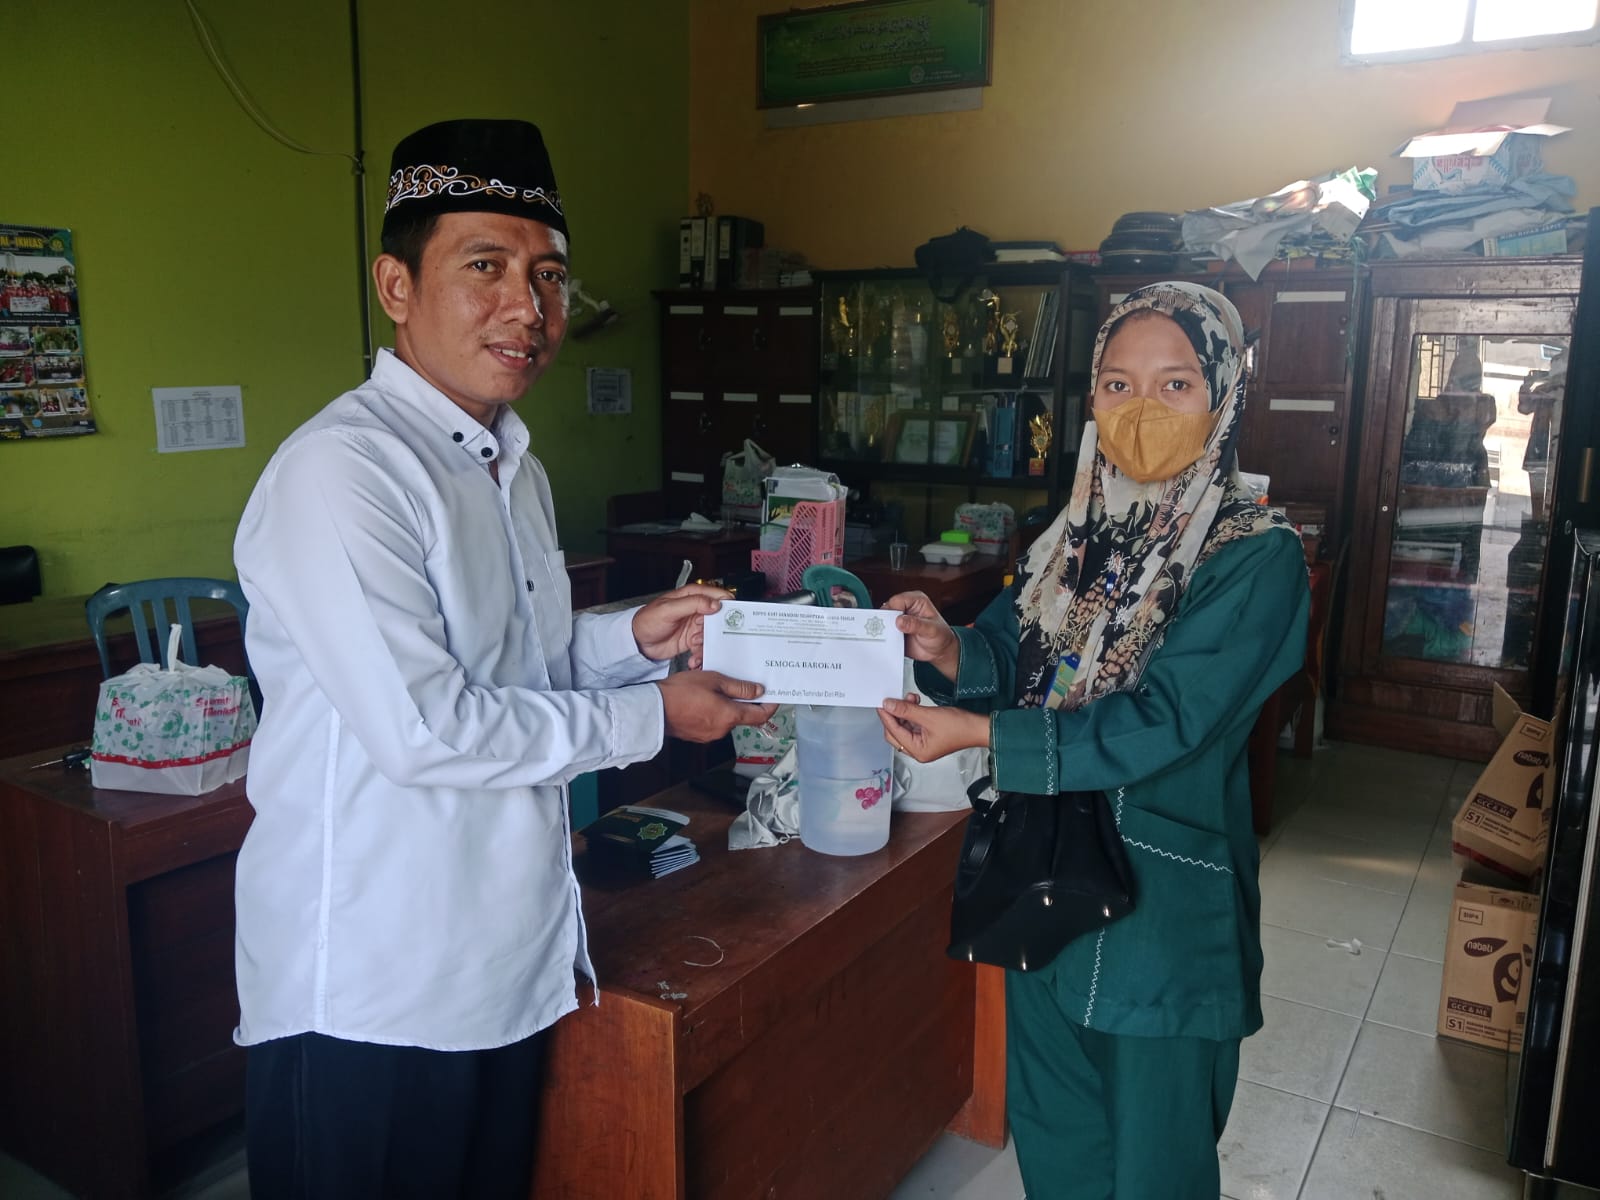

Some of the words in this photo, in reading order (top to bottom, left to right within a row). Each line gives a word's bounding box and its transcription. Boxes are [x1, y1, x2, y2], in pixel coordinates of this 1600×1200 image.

[765, 660, 800, 668] SEMOGA
[802, 661, 842, 669] BAROKAH
[1466, 811, 1482, 824] S1
[1467, 941, 1493, 953] nabati
[1451, 1002, 1467, 1011] GCC
[1475, 1008, 1488, 1017] ME
[1448, 1018, 1462, 1030] S1
